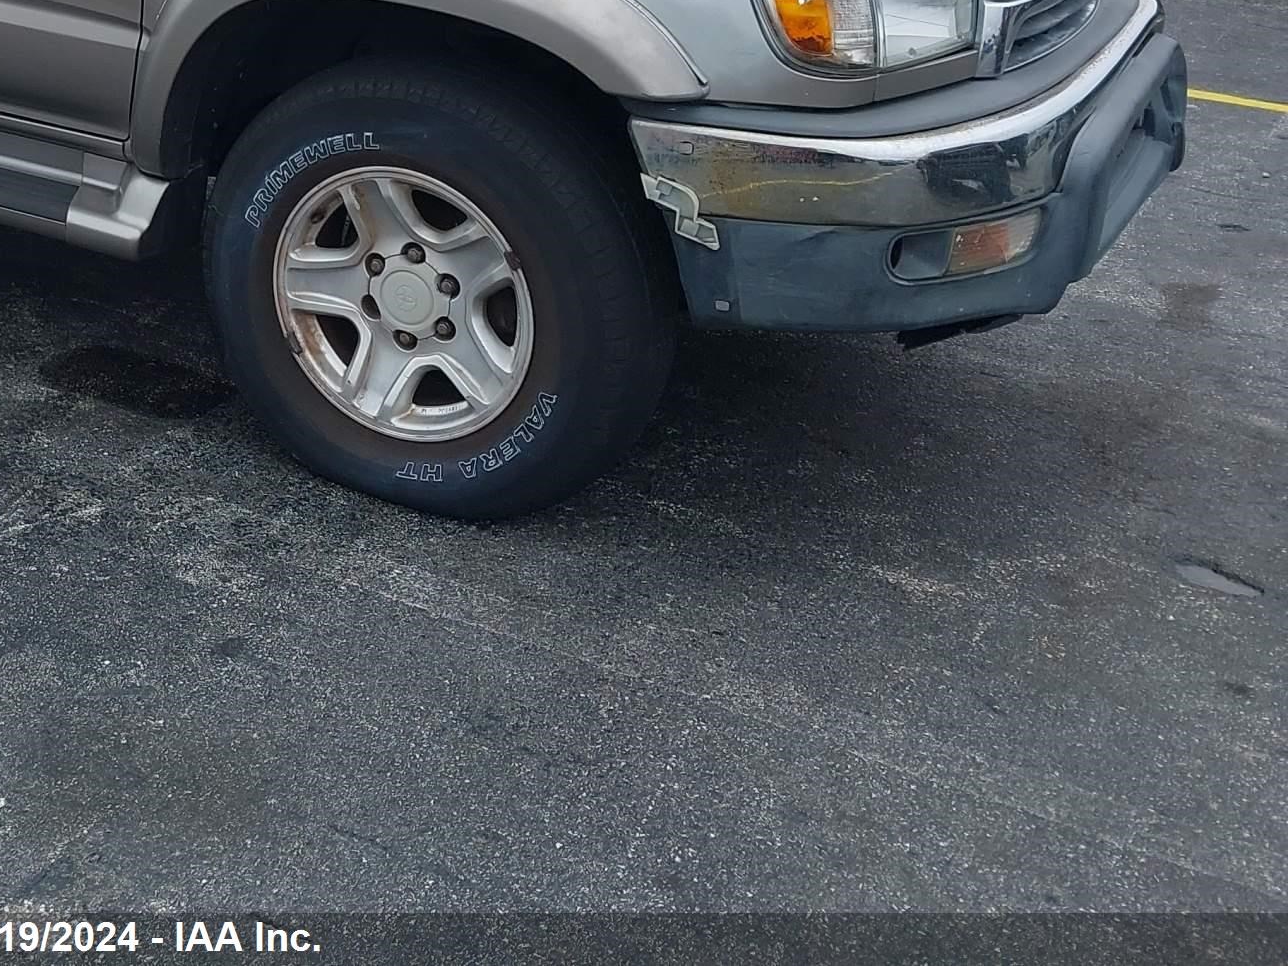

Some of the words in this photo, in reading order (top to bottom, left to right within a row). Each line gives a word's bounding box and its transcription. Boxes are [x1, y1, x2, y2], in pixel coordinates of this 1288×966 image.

[244, 131, 380, 229] PRIMEWELL
[396, 461, 443, 483] HT
[457, 391, 559, 479] VALERA
